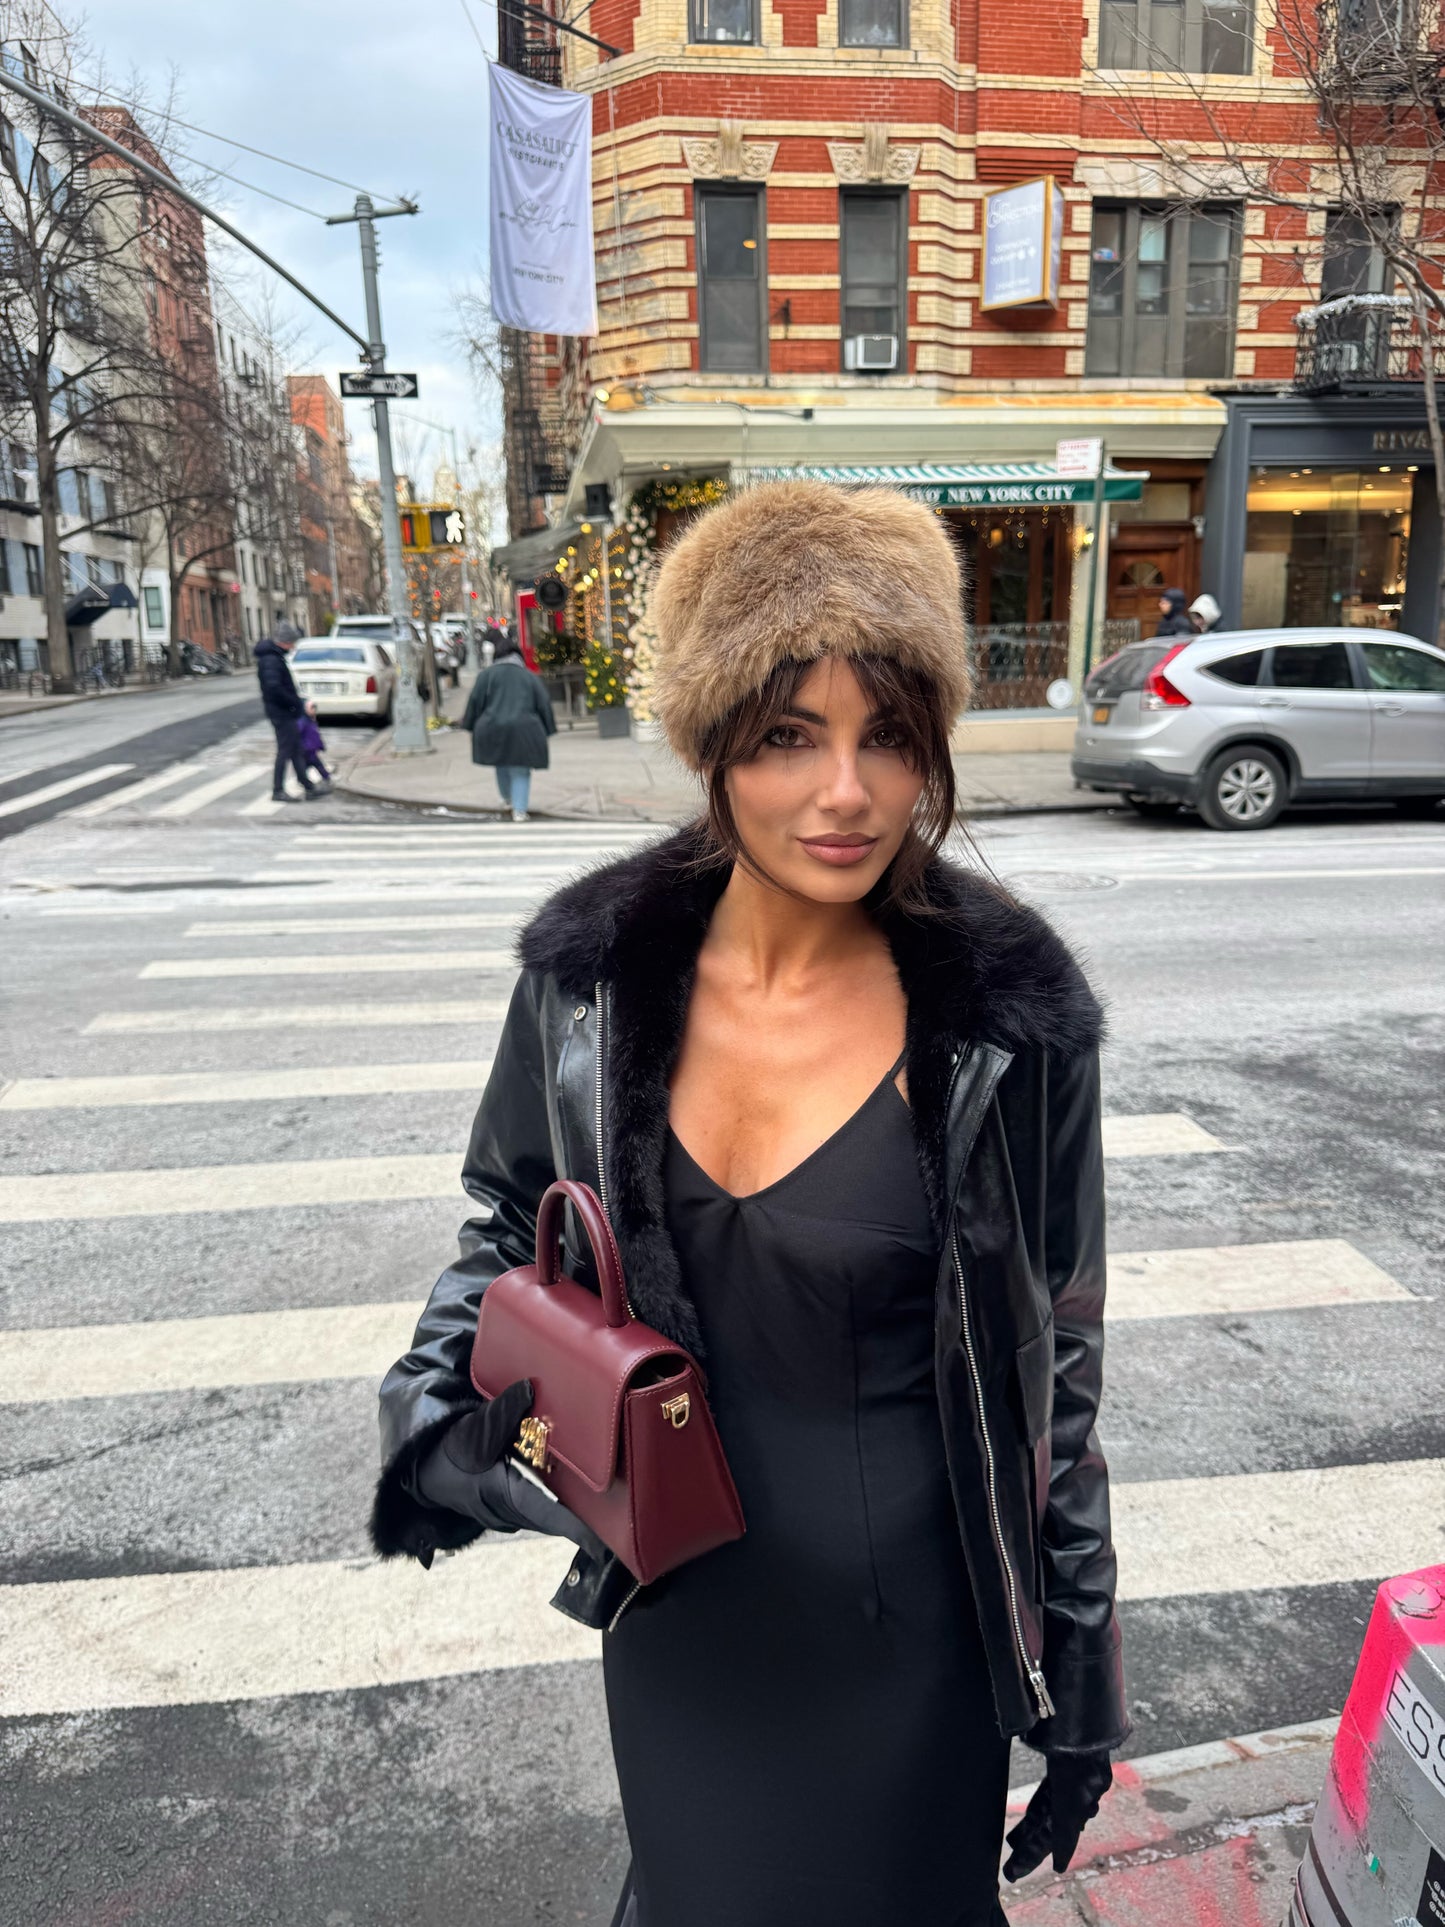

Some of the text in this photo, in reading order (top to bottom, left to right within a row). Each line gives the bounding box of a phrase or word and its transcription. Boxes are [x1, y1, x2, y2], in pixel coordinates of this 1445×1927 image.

[1373, 430, 1445, 450] RIVA
[948, 485, 987, 503] NEW
[987, 484, 1034, 502] YORK
[1034, 483, 1076, 501] CITY
